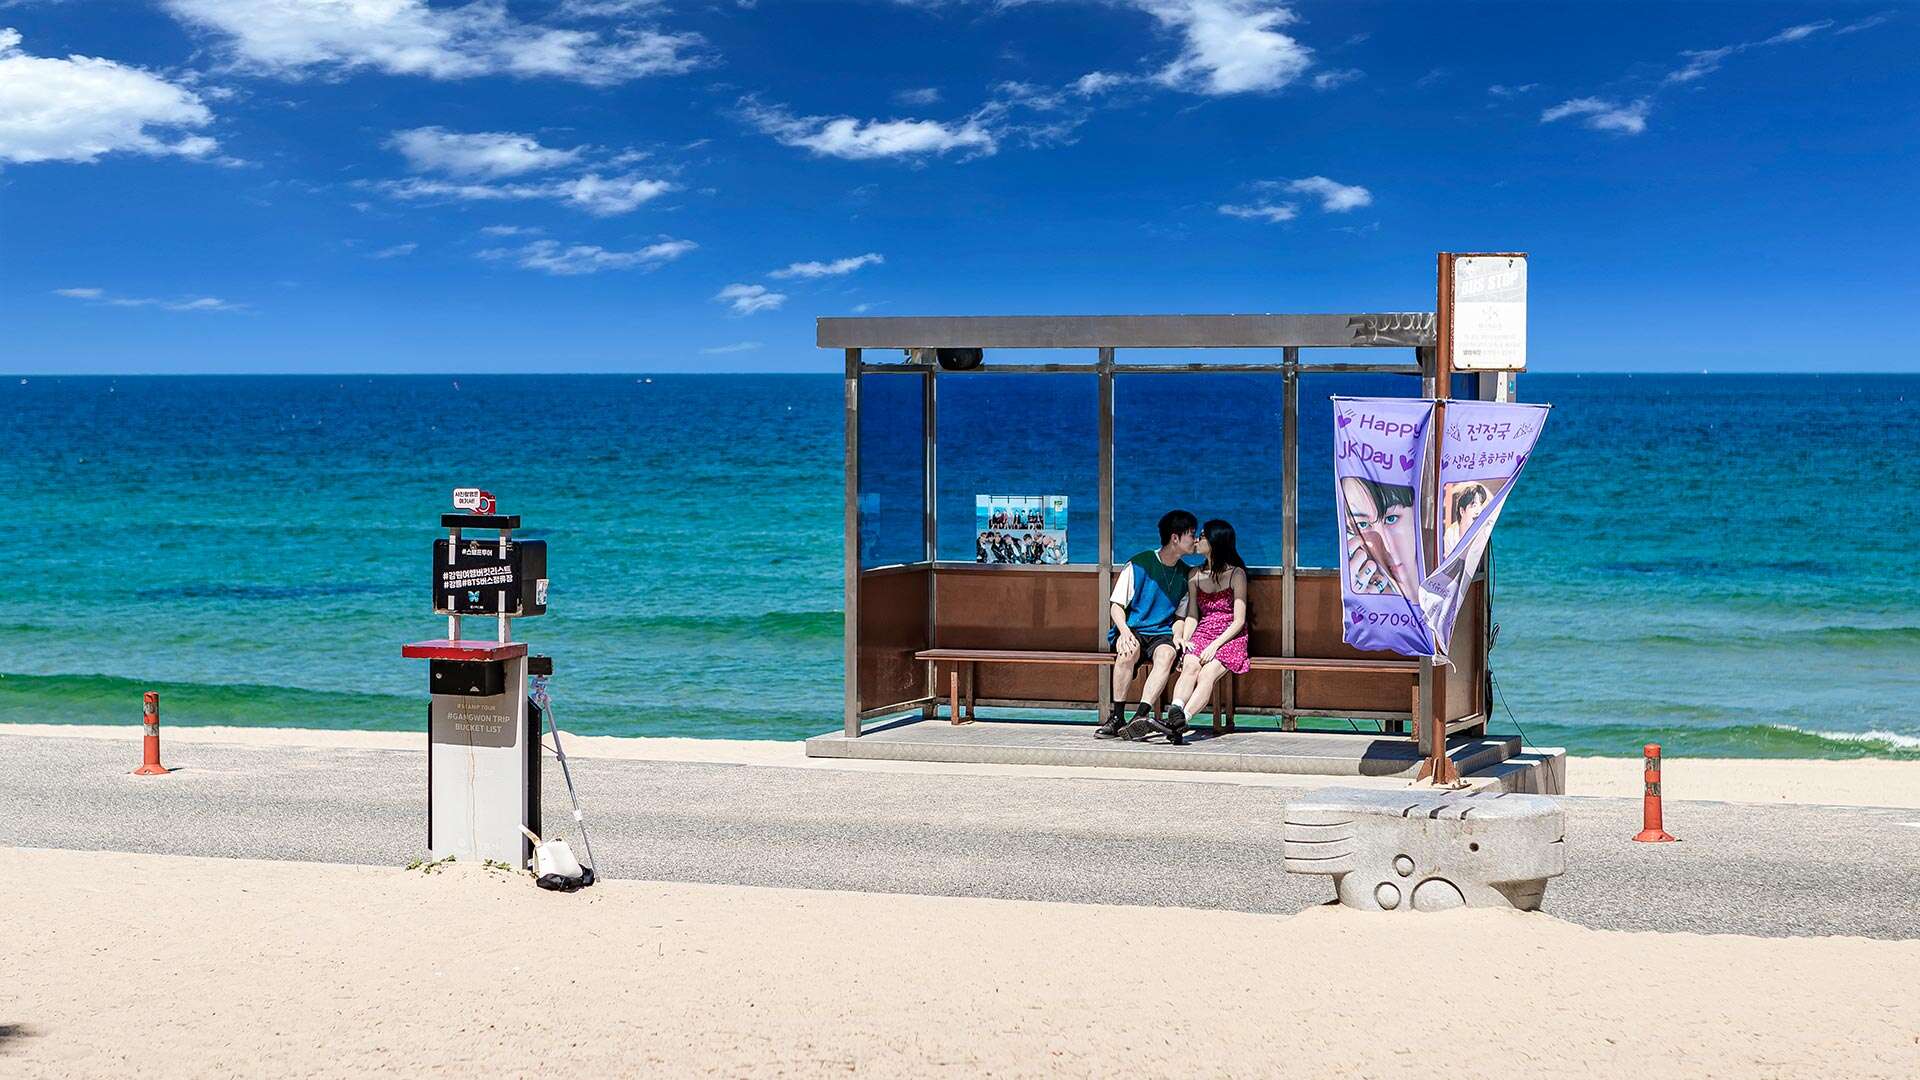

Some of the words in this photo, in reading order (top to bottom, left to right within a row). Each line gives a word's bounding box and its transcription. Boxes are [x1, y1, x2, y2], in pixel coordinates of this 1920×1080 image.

[1461, 279, 1485, 297] BUS
[1487, 270, 1520, 290] STOP
[1360, 414, 1423, 439] Happy
[1467, 423, 1511, 441] 전정국
[1452, 452, 1475, 469] 생일
[1478, 452, 1514, 468] 축하해
[447, 712, 493, 722] #GANGWON
[455, 723, 486, 732] BUCKET
